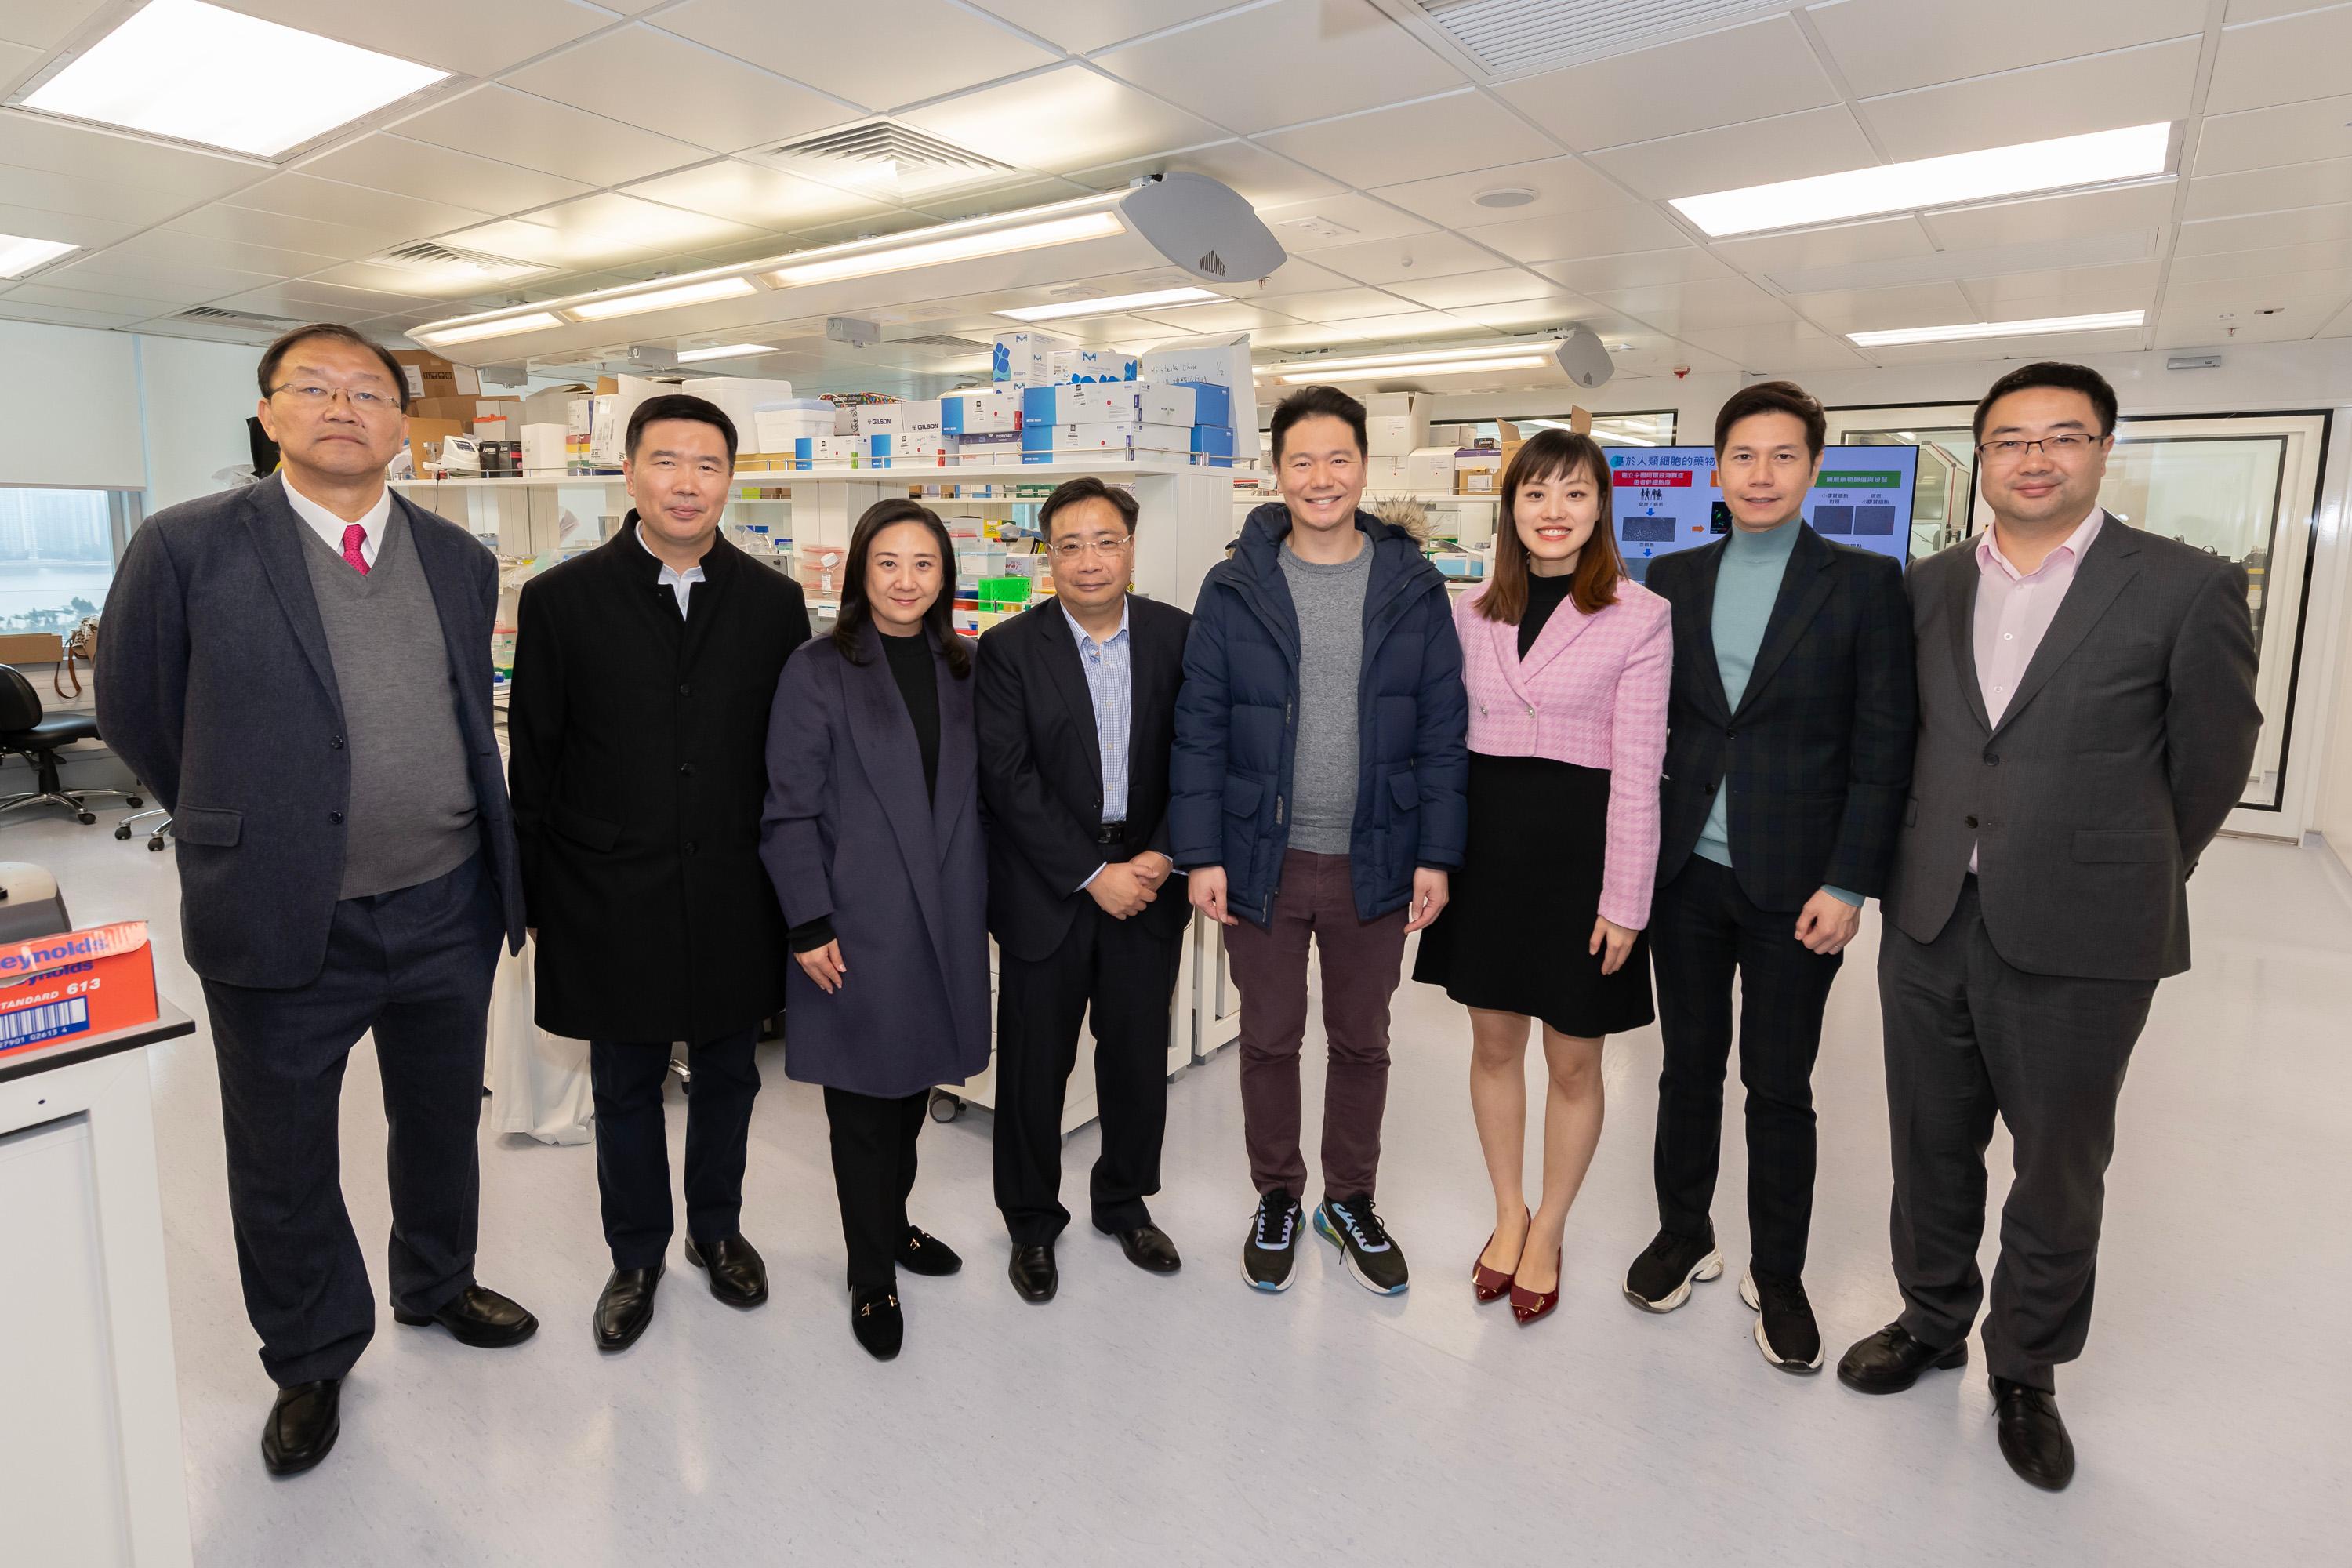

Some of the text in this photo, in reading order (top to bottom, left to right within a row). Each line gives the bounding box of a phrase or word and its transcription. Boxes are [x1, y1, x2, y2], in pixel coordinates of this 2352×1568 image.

[1200, 250, 1226, 277] WALDNER
[0, 938, 107, 970] eynolds
[67, 978, 101, 995] 613
